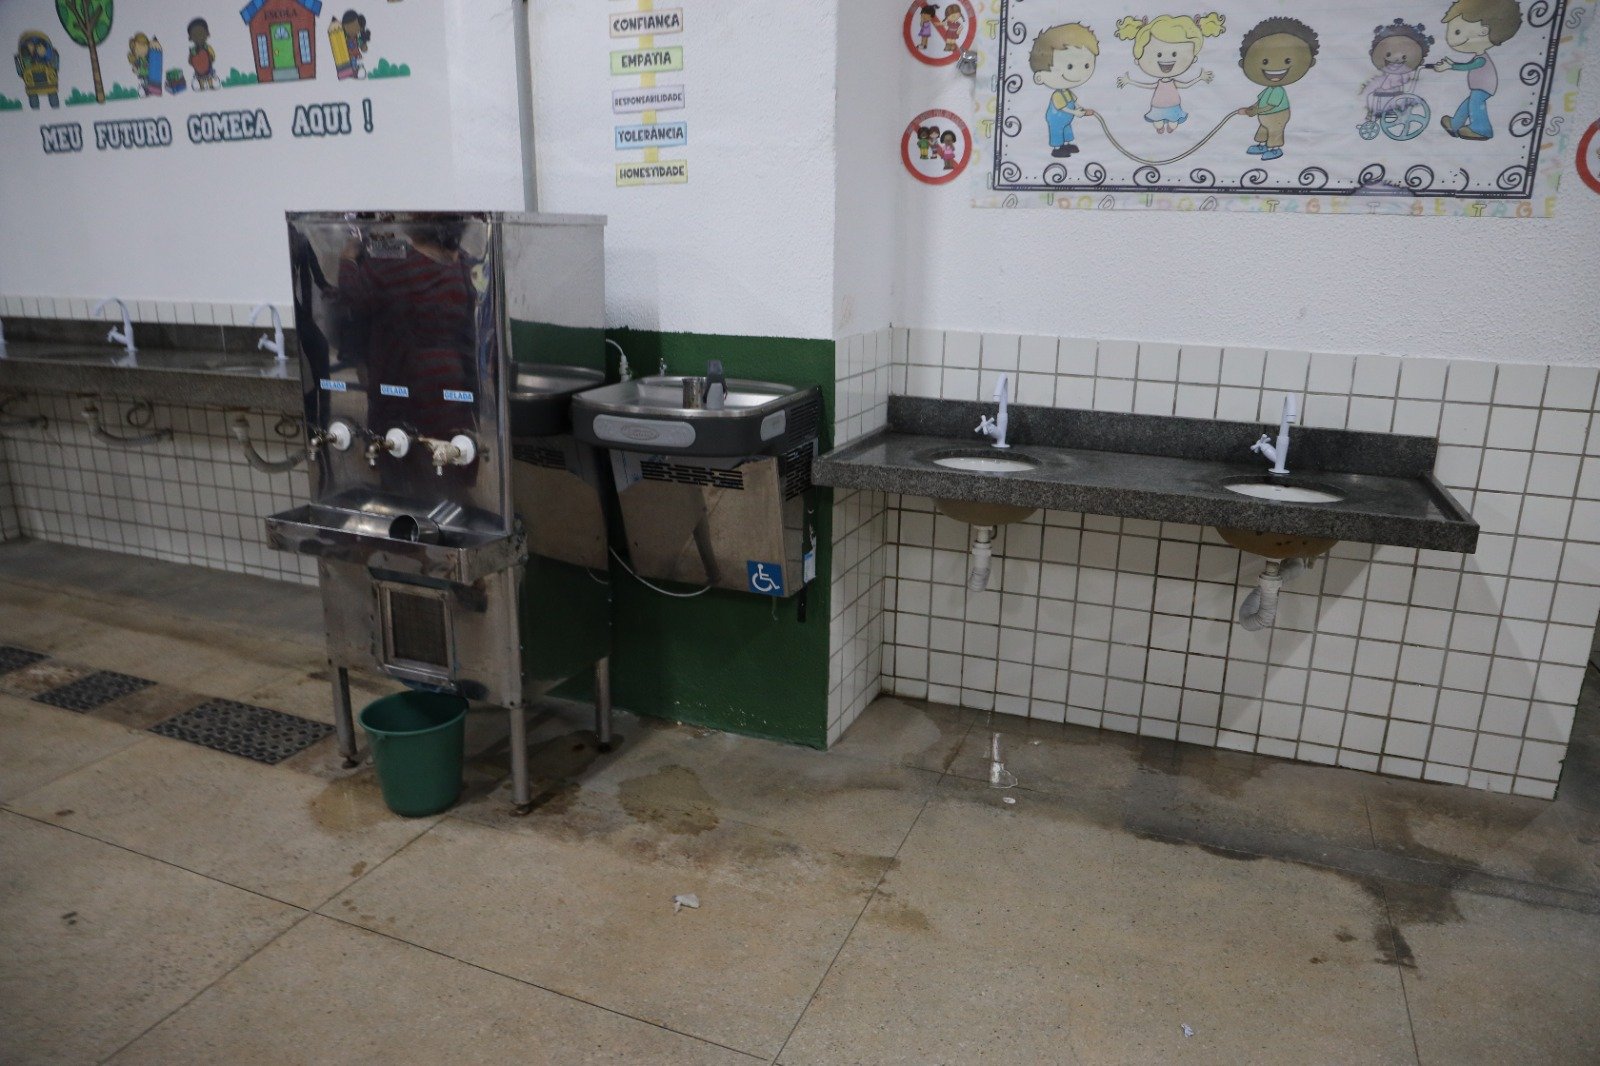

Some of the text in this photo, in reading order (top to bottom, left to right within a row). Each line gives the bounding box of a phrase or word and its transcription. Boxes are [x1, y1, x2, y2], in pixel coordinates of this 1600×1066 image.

[621, 51, 672, 68] EMPATIA
[615, 93, 683, 106] RESPONSABILIDADE
[40, 122, 83, 154] MEU
[94, 117, 173, 150] FUTURO
[618, 126, 684, 143] TOLERÂNCIA
[619, 165, 685, 180] HONESTIDADE
[381, 386, 409, 396] GELADA
[444, 391, 473, 401] GELADA
